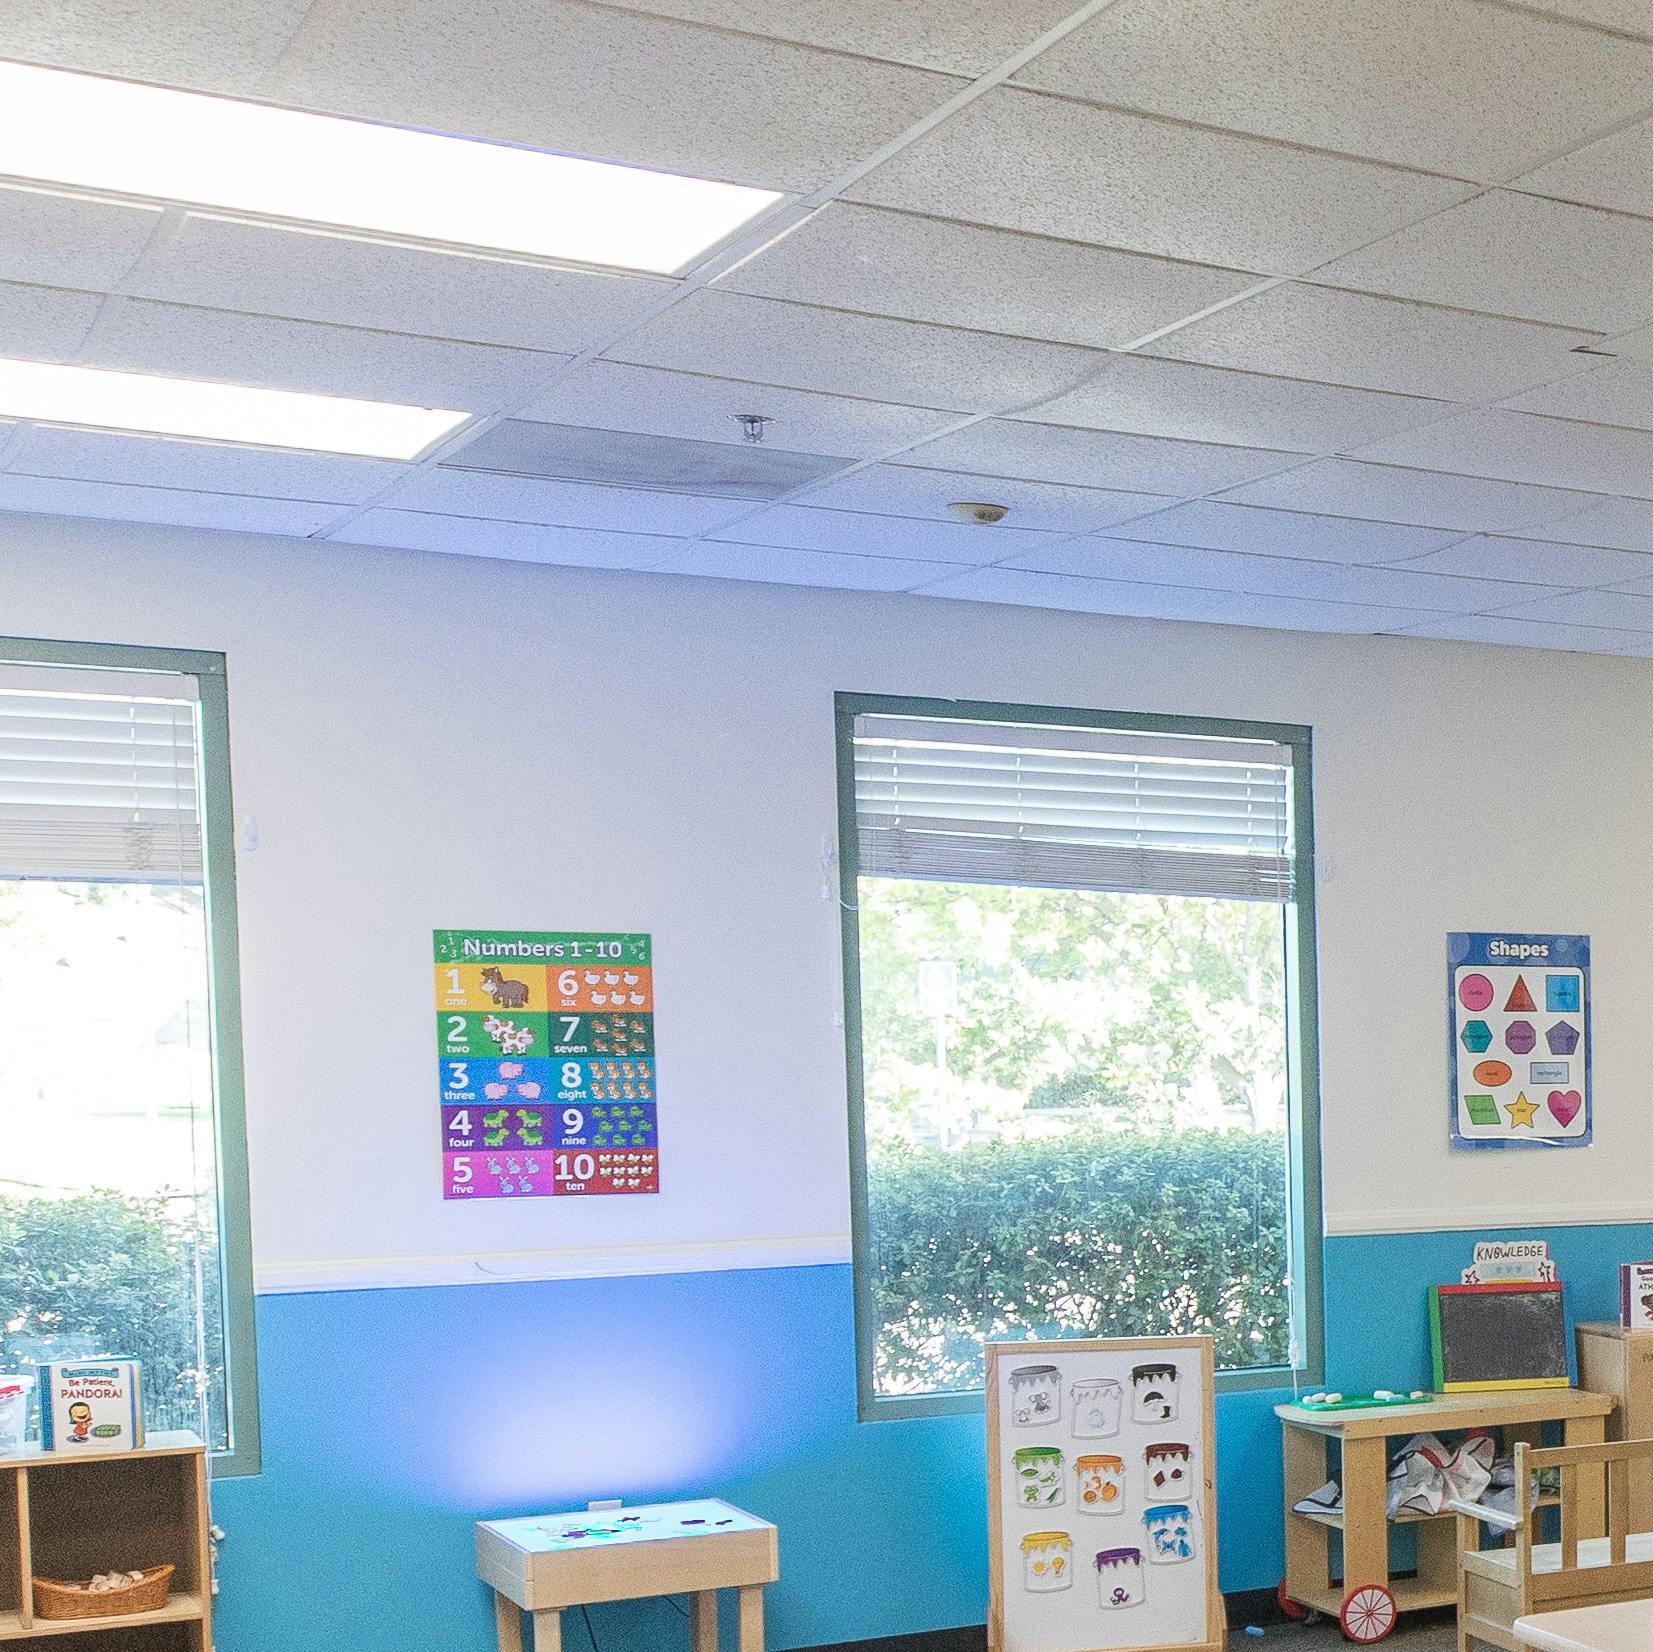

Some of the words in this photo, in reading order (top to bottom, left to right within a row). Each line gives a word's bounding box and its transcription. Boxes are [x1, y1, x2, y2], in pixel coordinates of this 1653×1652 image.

[463, 938, 565, 958] Numbers
[1489, 939, 1550, 960] Shapes
[447, 968, 465, 995] 1
[557, 969, 580, 996] 6
[447, 1015, 469, 1043] 2
[559, 1016, 581, 1042] 7
[447, 1044, 470, 1054] two
[553, 1044, 588, 1054] seven
[448, 1062, 470, 1089] 3
[560, 1061, 583, 1089] 8
[444, 1090, 476, 1101] three
[557, 1089, 588, 1101] eight
[448, 1109, 473, 1136] 4
[562, 1108, 584, 1134] 9
[449, 1137, 475, 1148] four
[561, 1135, 587, 1146] nine
[452, 1156, 474, 1183] 5
[554, 1153, 595, 1181] 10
[452, 1183, 474, 1194] five
[565, 1181, 586, 1191] ten
[1476, 1245, 1544, 1261] KNOWLEDGE
[68, 1379, 80, 1388] Be
